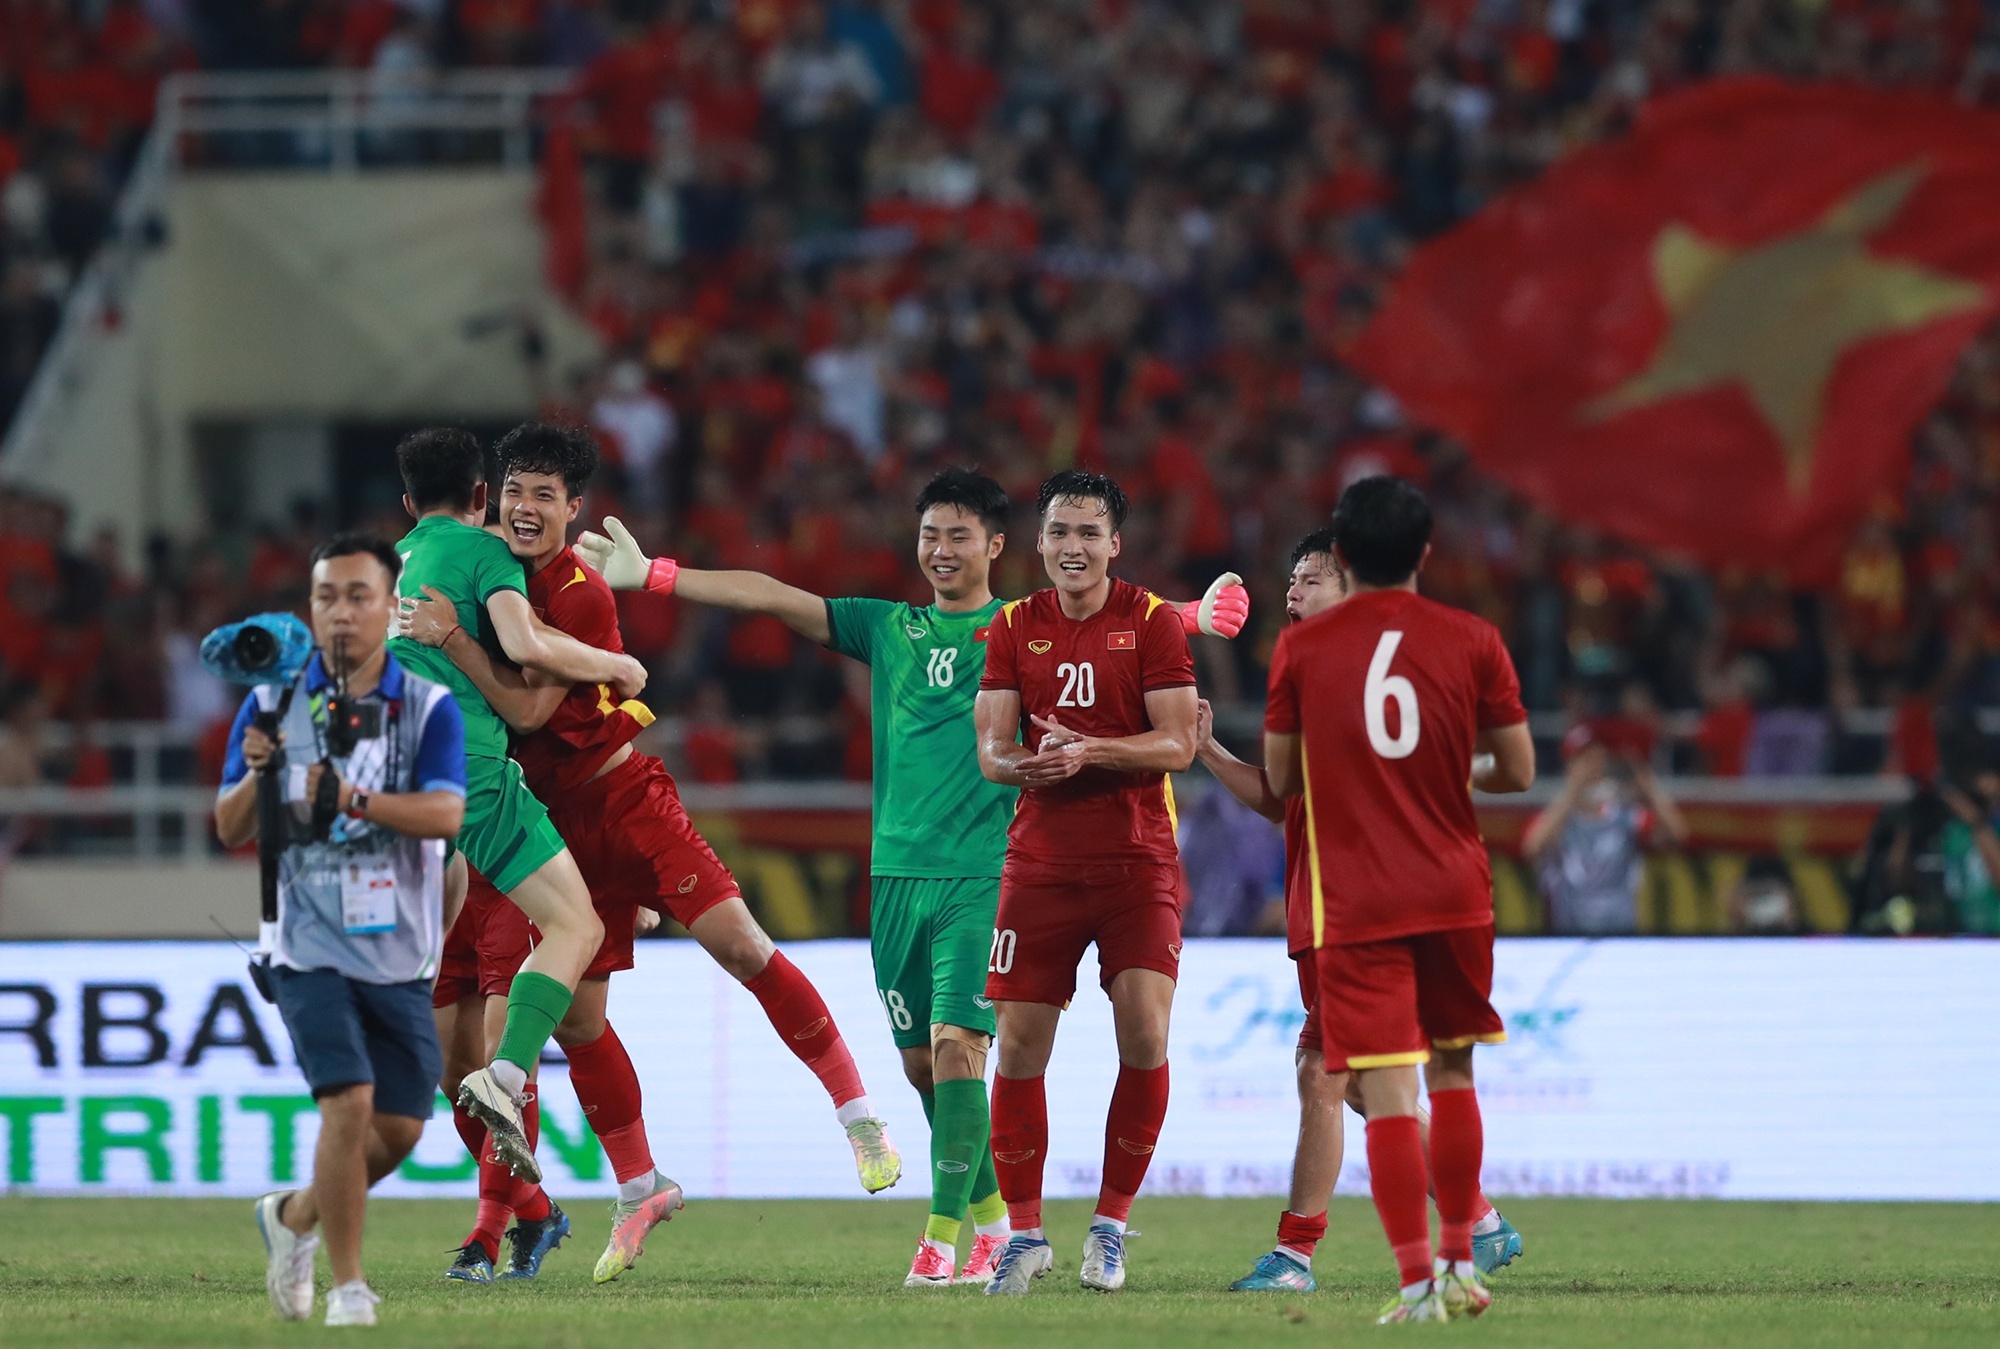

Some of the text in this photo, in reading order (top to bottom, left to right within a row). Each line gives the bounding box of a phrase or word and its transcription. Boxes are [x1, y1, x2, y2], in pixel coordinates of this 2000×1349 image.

[926, 647, 958, 688] 18
[1056, 661, 1096, 708] 20
[1364, 630, 1421, 759] 6
[987, 927, 1017, 975] 20
[878, 987, 913, 1032] 18
[0, 1095, 604, 1184] TRITON
